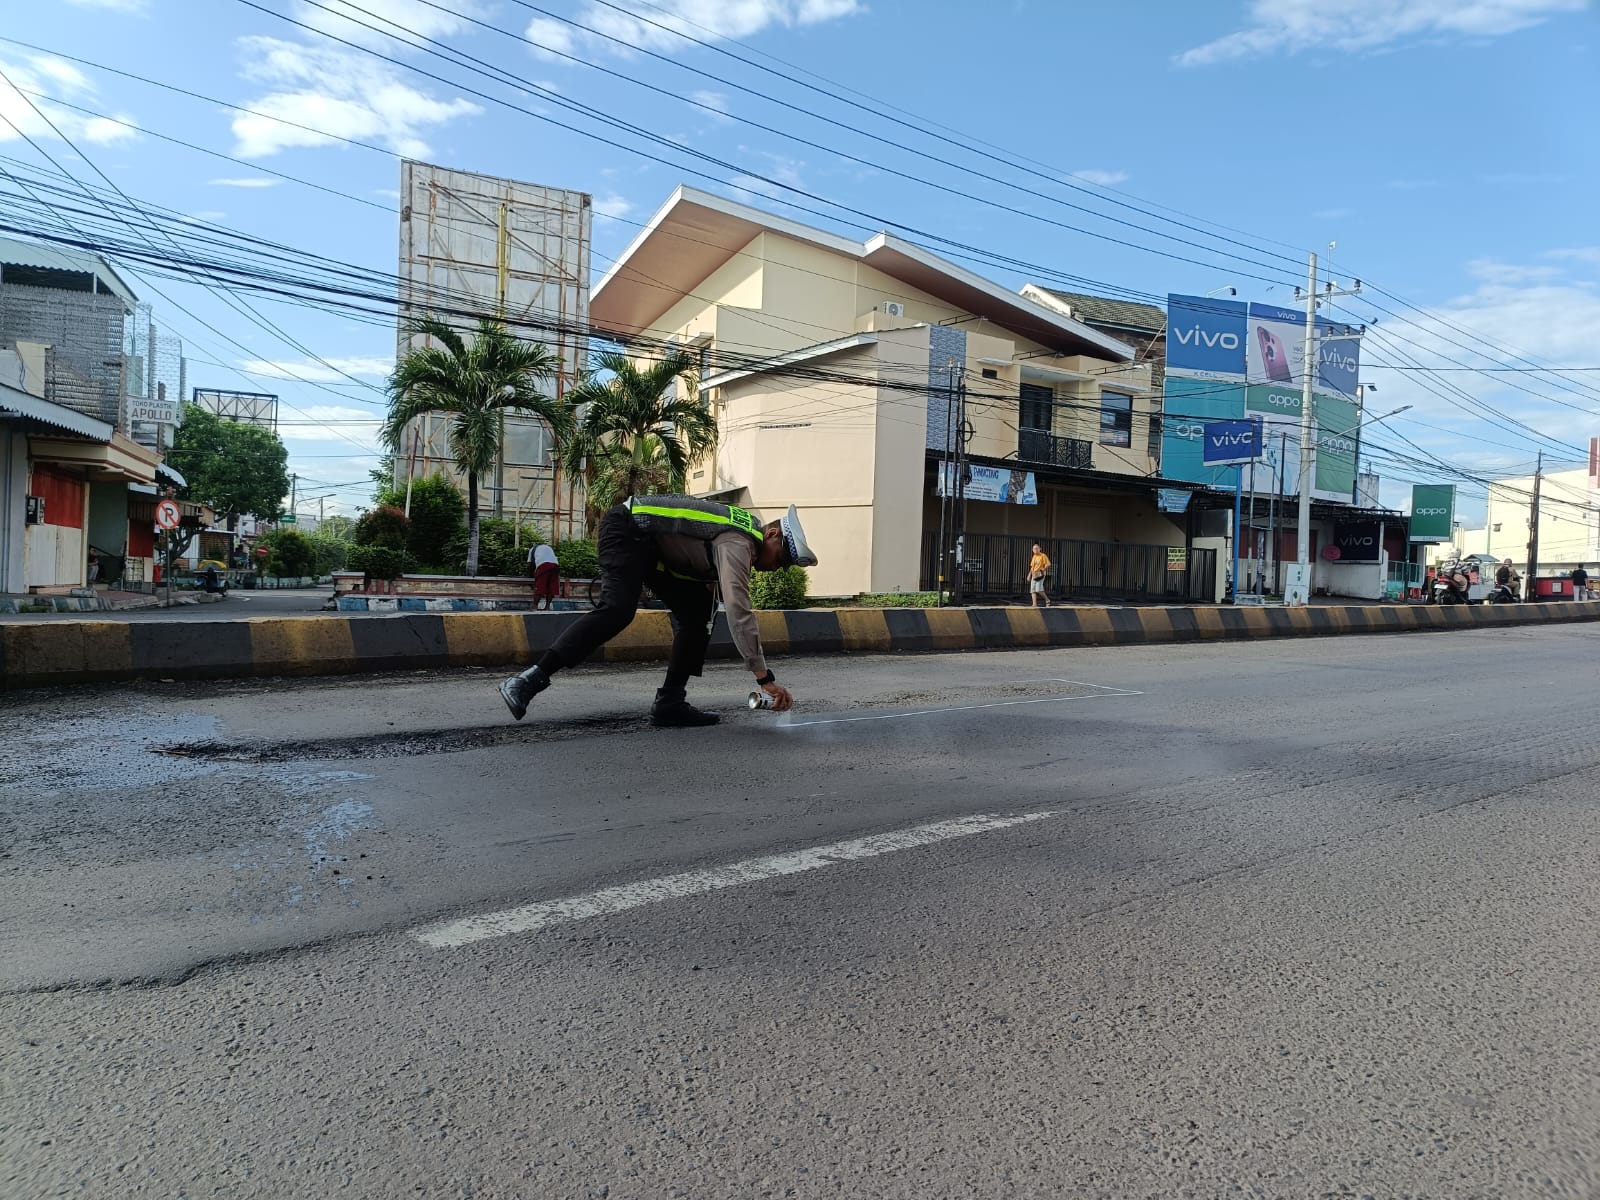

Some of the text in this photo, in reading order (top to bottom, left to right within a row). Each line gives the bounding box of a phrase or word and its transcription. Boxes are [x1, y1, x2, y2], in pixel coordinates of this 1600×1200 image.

[1277, 311, 1296, 320] vivo
[1174, 324, 1238, 349] vivo
[1323, 347, 1356, 373] vivo
[1268, 394, 1300, 408] oppo
[131, 408, 172, 420] APOLLO
[1176, 424, 1204, 440] op
[1212, 432, 1253, 447] vivo
[1321, 436, 1353, 455] oppo
[1416, 507, 1447, 516] oppo
[1340, 534, 1374, 546] vivo
